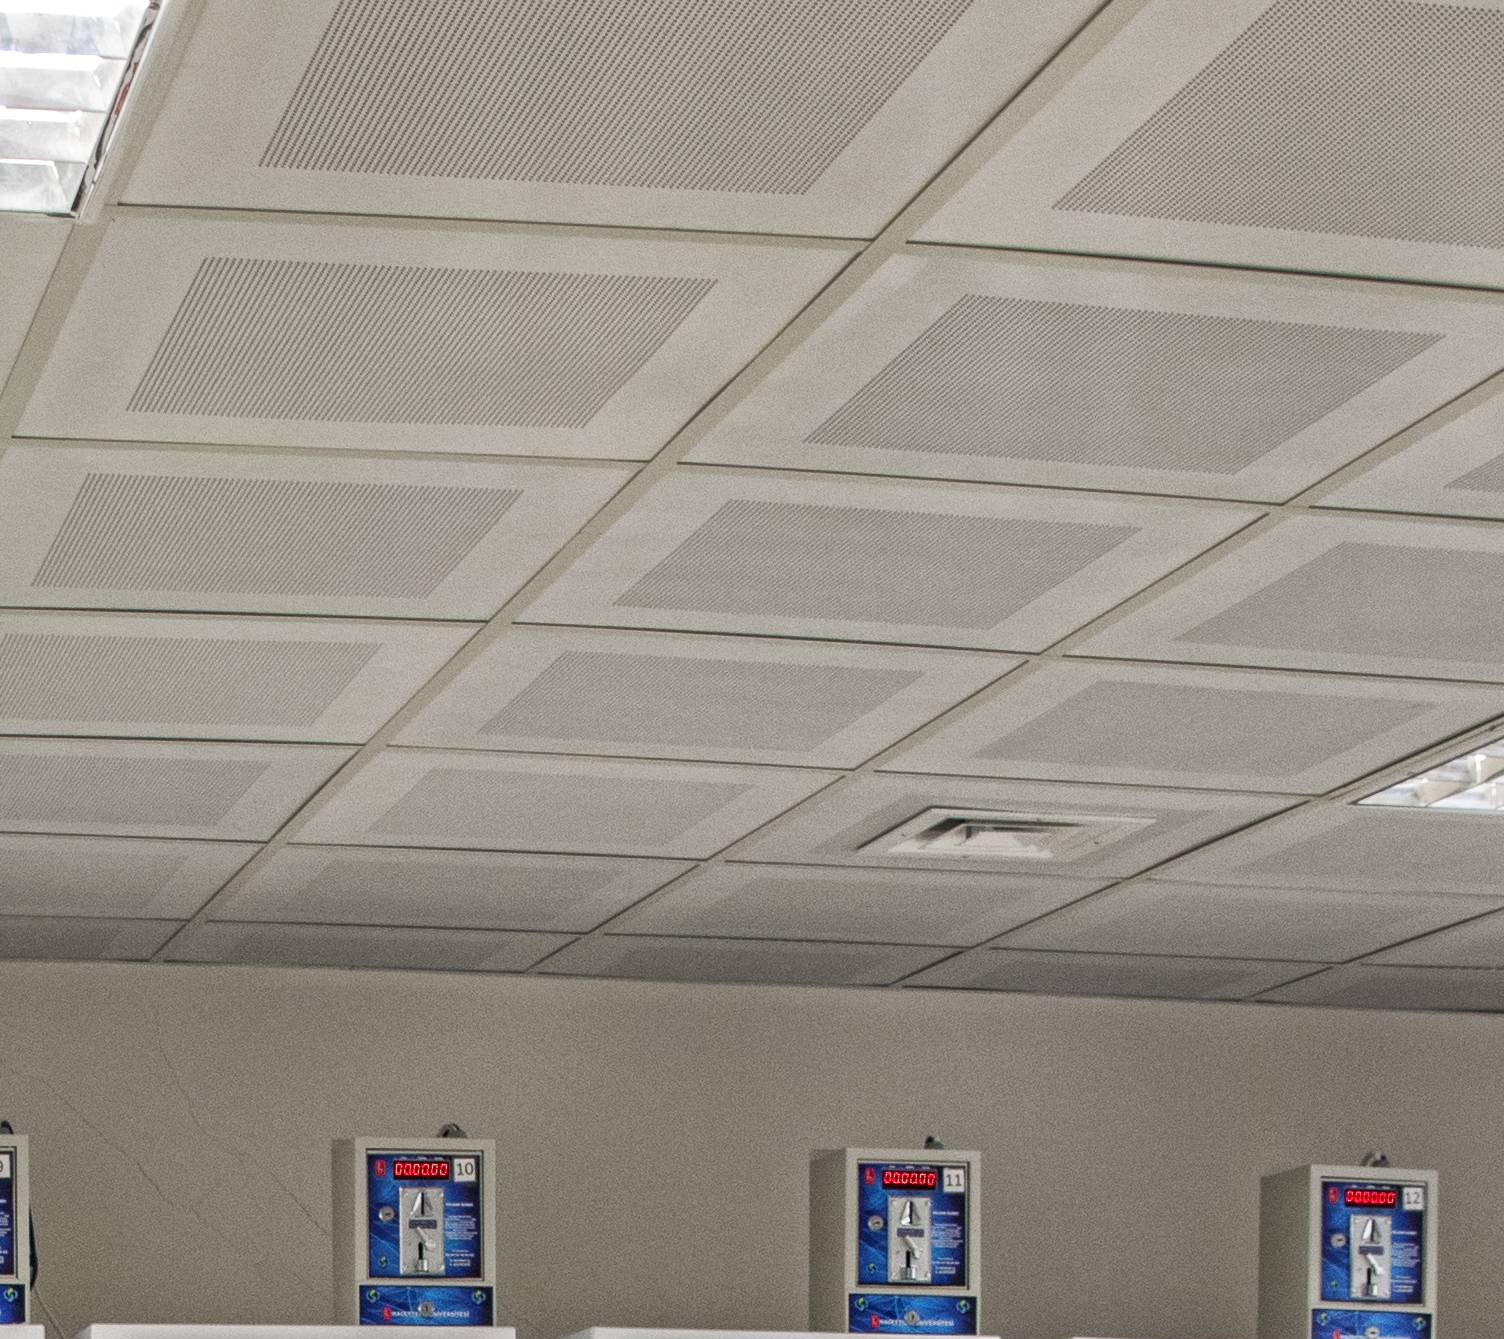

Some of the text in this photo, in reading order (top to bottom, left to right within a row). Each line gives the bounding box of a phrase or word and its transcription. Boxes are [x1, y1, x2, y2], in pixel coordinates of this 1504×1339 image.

[456, 1162, 474, 1176] 10
[946, 1173, 962, 1187] 11
[1405, 1191, 1420, 1205] 12
